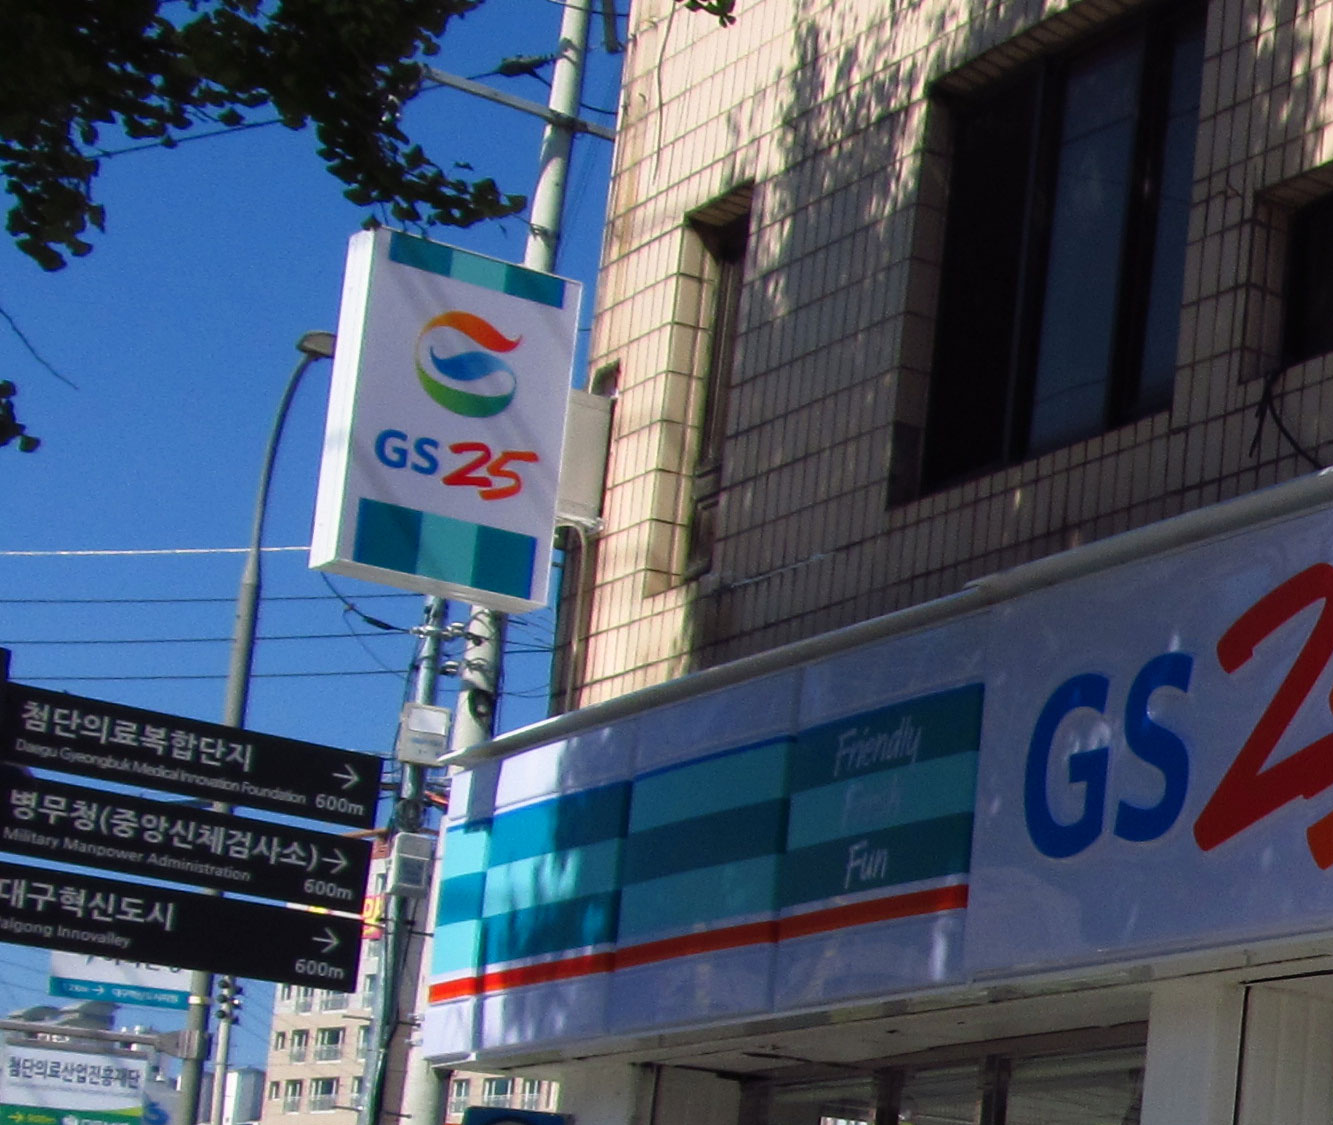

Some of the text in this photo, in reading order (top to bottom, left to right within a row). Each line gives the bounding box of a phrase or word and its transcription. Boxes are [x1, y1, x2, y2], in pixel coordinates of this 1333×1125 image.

[374, 429, 539, 501] GS25
[21, 700, 252, 773] 첨단의료복합단지
[833, 714, 922, 777] Friendly
[16, 738, 58, 758] Daegu
[60, 747, 132, 770] Gyeongbuk
[241, 781, 307, 804] Foundation
[315, 793, 364, 817] 600m
[2, 825, 353, 901] Military Manpower Administration 600m
[10, 788, 318, 872] 병무청(중앙신체검사소)
[843, 838, 890, 889] Fun
[0, 878, 176, 931] 대구혁신도시
[0, 916, 345, 980] algong Innovalley 600m
